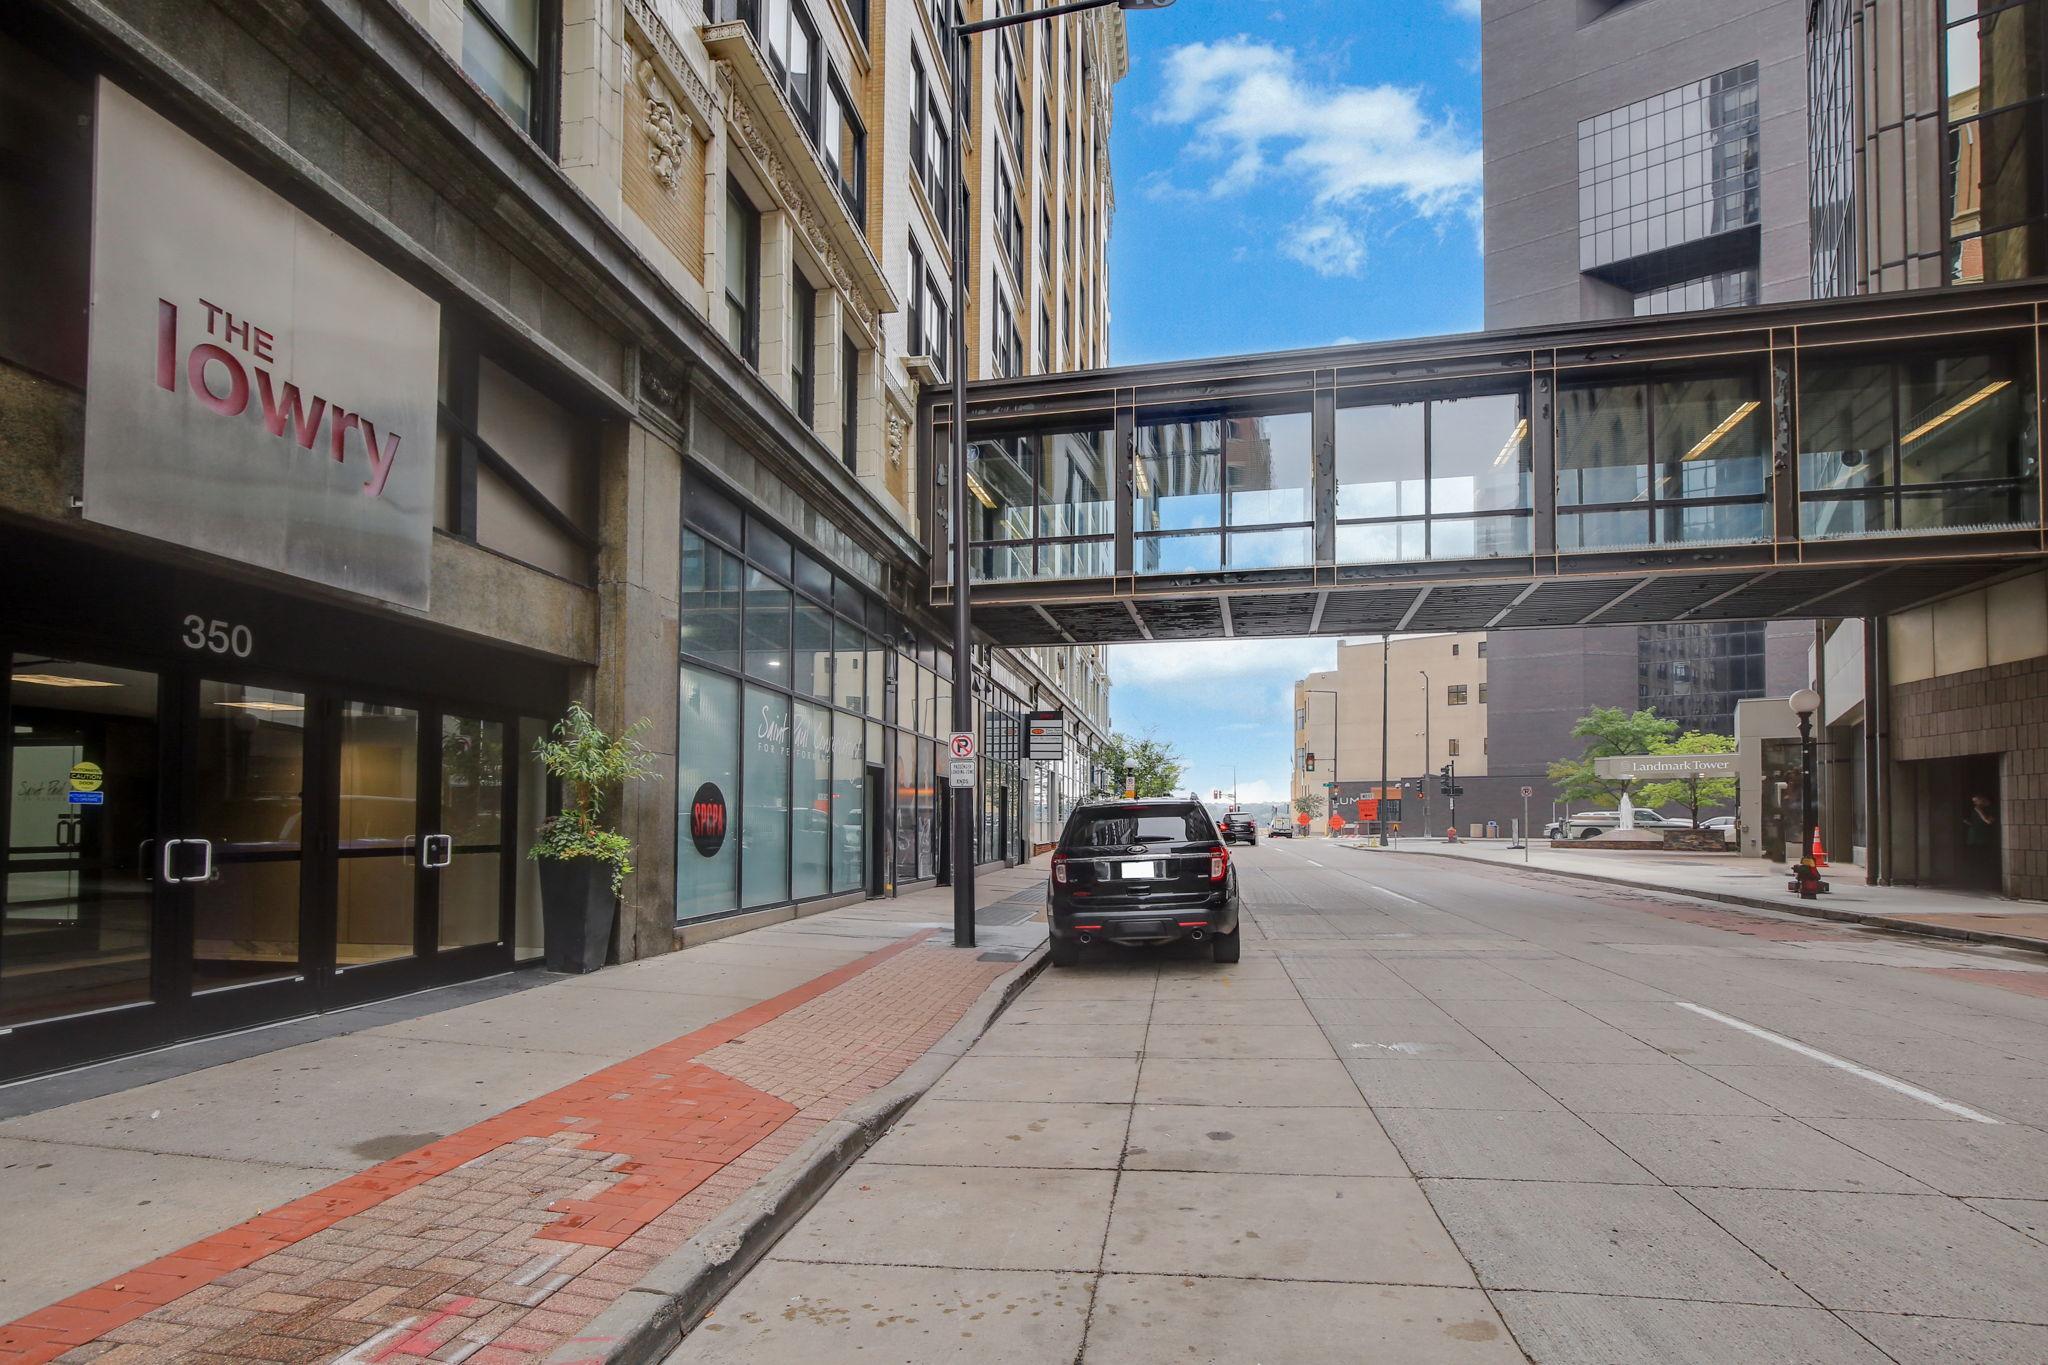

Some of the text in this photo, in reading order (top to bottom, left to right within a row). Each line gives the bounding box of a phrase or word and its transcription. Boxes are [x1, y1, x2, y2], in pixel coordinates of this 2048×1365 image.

[199, 298, 274, 364] THE
[182, 614, 253, 658] 350
[757, 705, 790, 744] Saint
[1632, 760, 1729, 772] Landmark Tower
[694, 802, 725, 837] SPCPA
